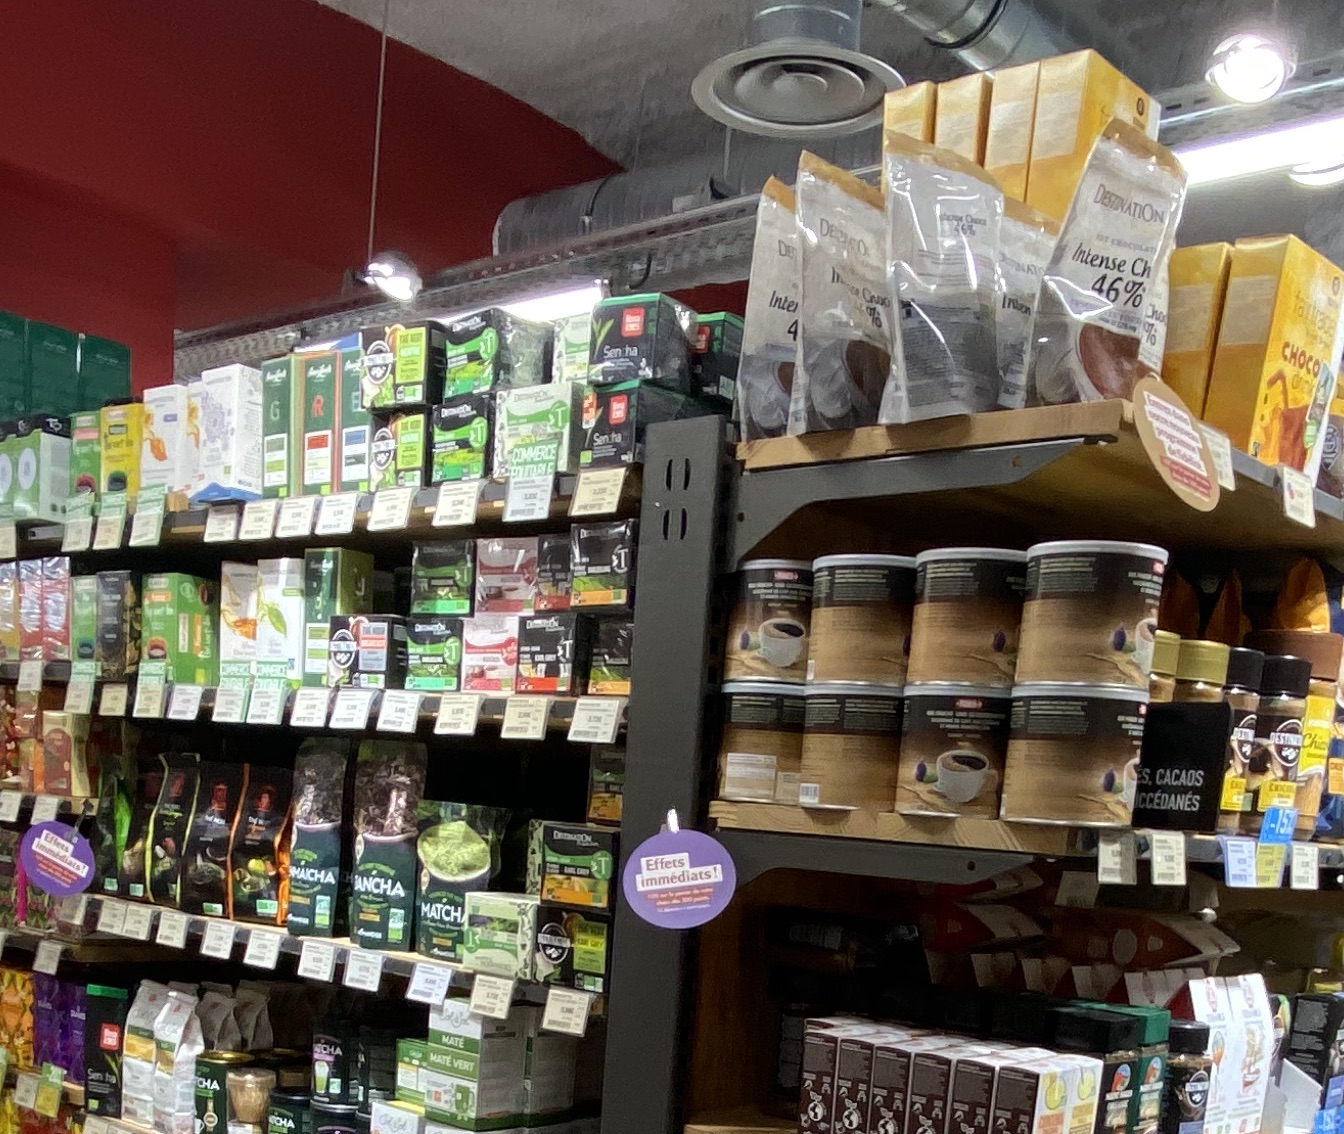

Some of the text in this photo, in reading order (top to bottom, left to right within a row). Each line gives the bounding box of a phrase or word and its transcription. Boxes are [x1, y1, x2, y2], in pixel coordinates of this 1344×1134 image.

[1093, 184, 1165, 224] DESTINATION
[1072, 242, 1127, 273] Intense
[1091, 273, 1147, 308] 46%
[1281, 341, 1321, 379] CHOCO
[1155, 768, 1205, 787] CACAOS
[645, 857, 686, 872] Effets
[442, 1034, 465, 1048] MATÉ
[429, 1051, 475, 1072] MATÉ VERT
